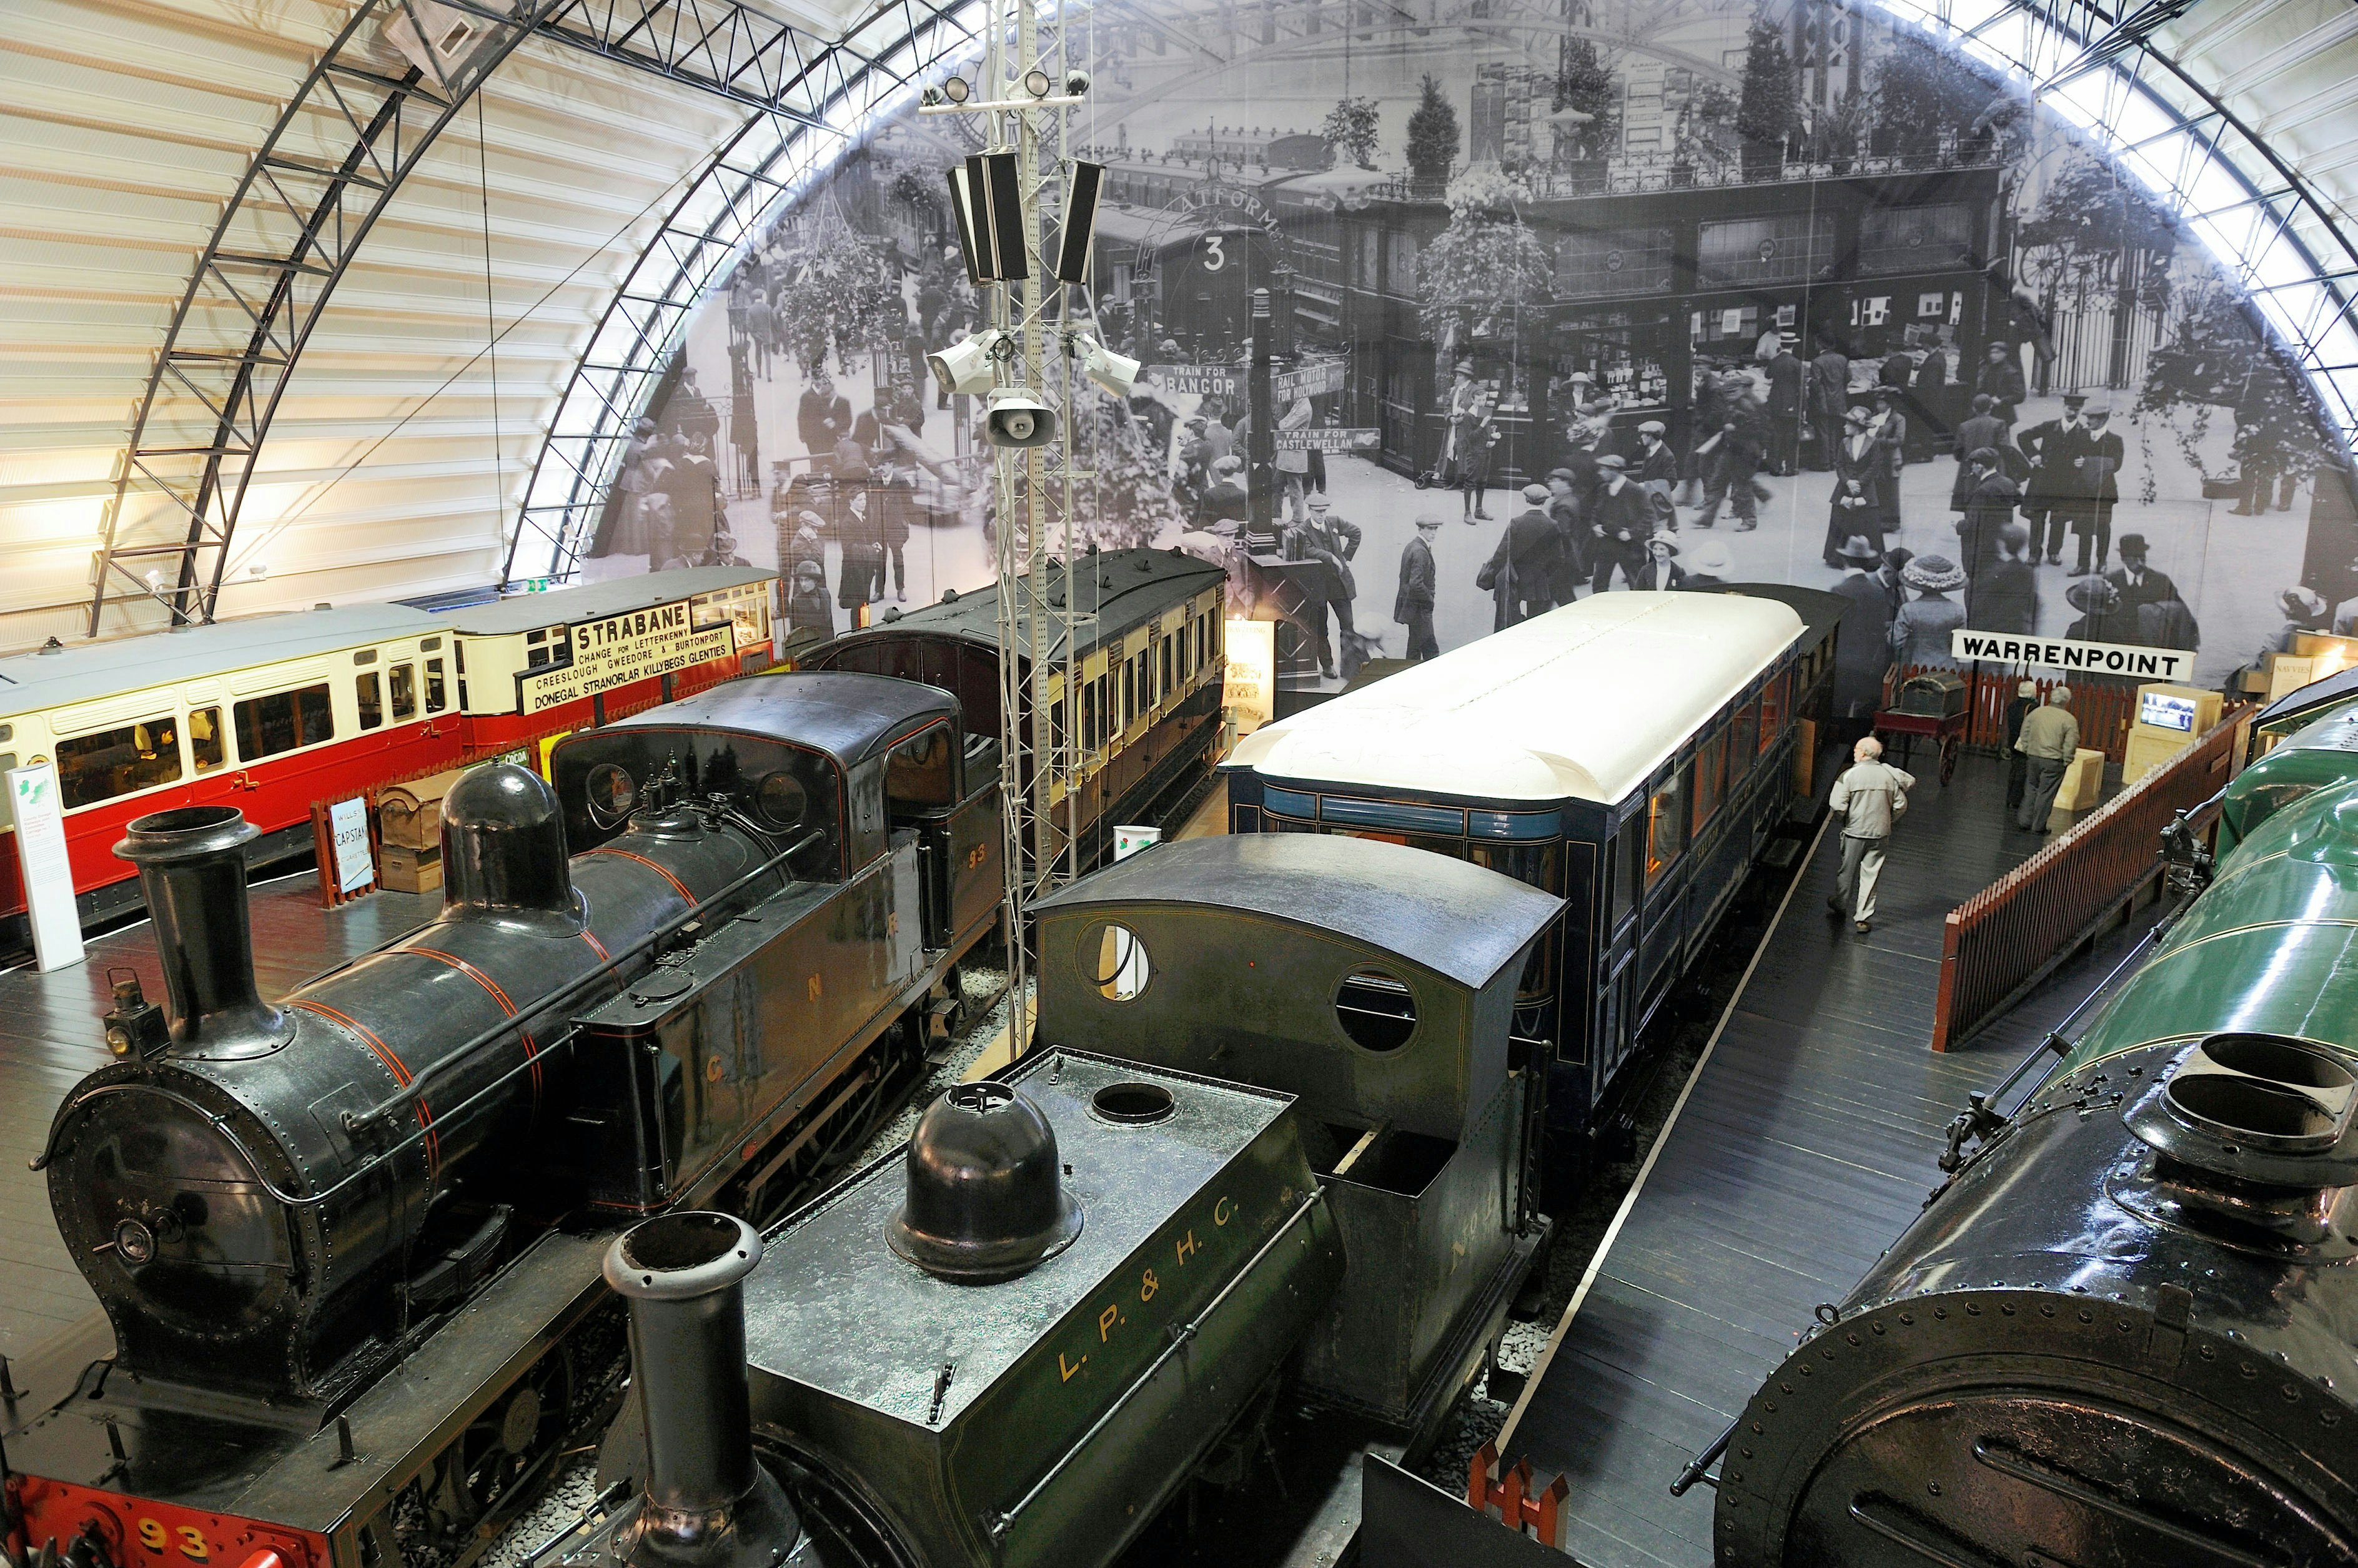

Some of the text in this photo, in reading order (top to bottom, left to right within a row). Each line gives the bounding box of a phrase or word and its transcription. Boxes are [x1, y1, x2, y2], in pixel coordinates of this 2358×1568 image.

[1204, 236, 1224, 270] 3
[1167, 377, 1235, 395] BANGOR
[1173, 367, 1226, 377] TRAIN FOR
[1278, 368, 1326, 390] RAIL MOTOR
[1277, 380, 1326, 403] FOR HOLYWOOD
[1276, 439, 1352, 450] CASTLEWELLAN
[578, 606, 684, 649] STRABANE
[537, 665, 597, 689] CREESLOUGH
[608, 649, 652, 669] GWEEDORE
[676, 631, 723, 651] BURTONPORT
[579, 629, 688, 664] CHANGE FOR LETTERKENNY
[1963, 638, 2179, 676] WARRENPOINT
[535, 644, 726, 709] DONEGAL STRANORLAR KILLYBEGS GLENTIES
[2275, 665, 2310, 674] NAVVIES
[505, 751, 527, 764] COCOA
[969, 842, 986, 869] 93
[808, 972, 821, 1002] N
[1058, 1196, 1239, 1383] L. P. & H. C.
[137, 1517, 209, 1561] 93
